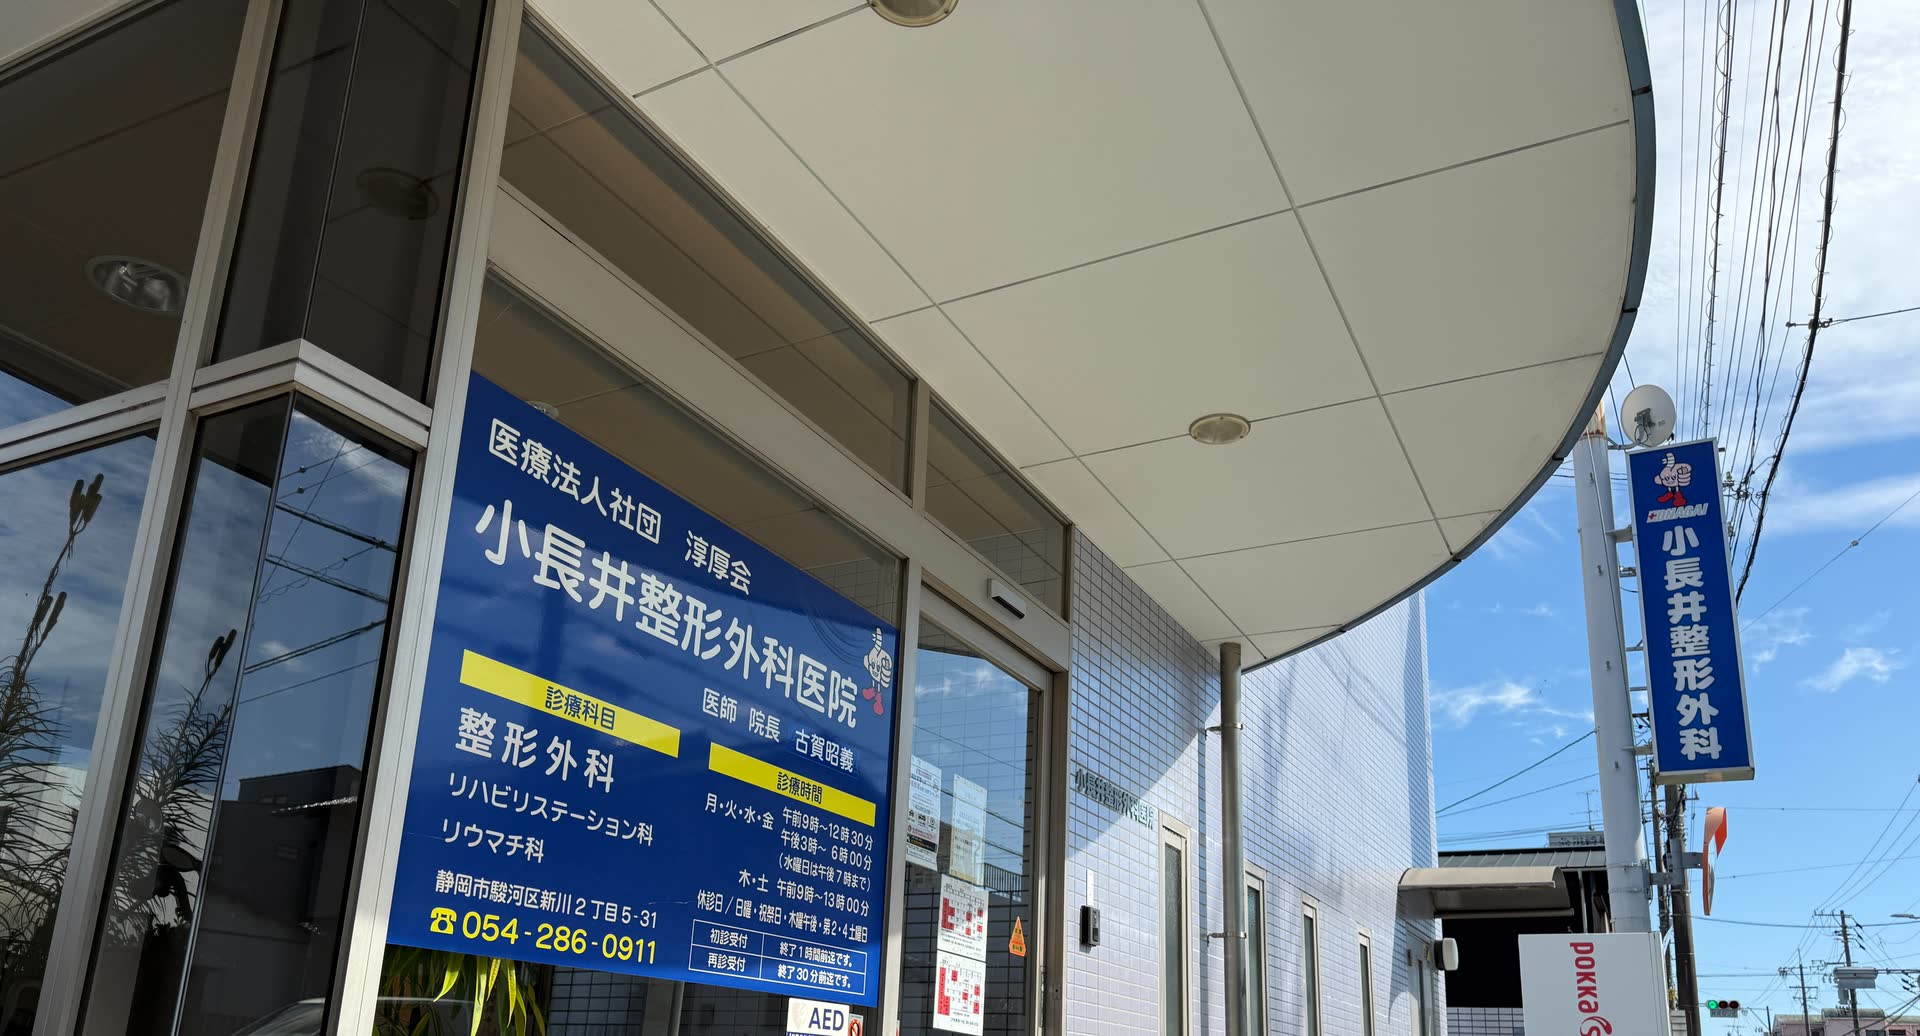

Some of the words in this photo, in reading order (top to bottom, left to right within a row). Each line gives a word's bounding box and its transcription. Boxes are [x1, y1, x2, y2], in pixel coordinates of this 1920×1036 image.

[488, 418, 661, 544] 医療法人社団
[684, 530, 752, 595] 淳厚会
[475, 499, 859, 729] 小長井整形外科医院
[1662, 525, 1722, 761] 小長井整形外科
[544, 686, 616, 731] 診療科目
[702, 688, 738, 723] 医師
[748, 707, 781, 742] 院長
[795, 728, 854, 773] 古賀昭義
[455, 707, 615, 793] 整形外科
[449, 772, 653, 846] リハビリステーション科
[776, 771, 823, 804] 診療時間
[442, 818, 544, 863] リウマチ科
[435, 869, 657, 929] 静岡市駿河区新川2丁目5-31
[738, 869, 769, 893] 木・土
[462, 911, 657, 964] 054-286-0911
[708, 952, 747, 972] 再診受付
[710, 928, 748, 949] 初診受付
[808, 1007, 844, 1031] AED
